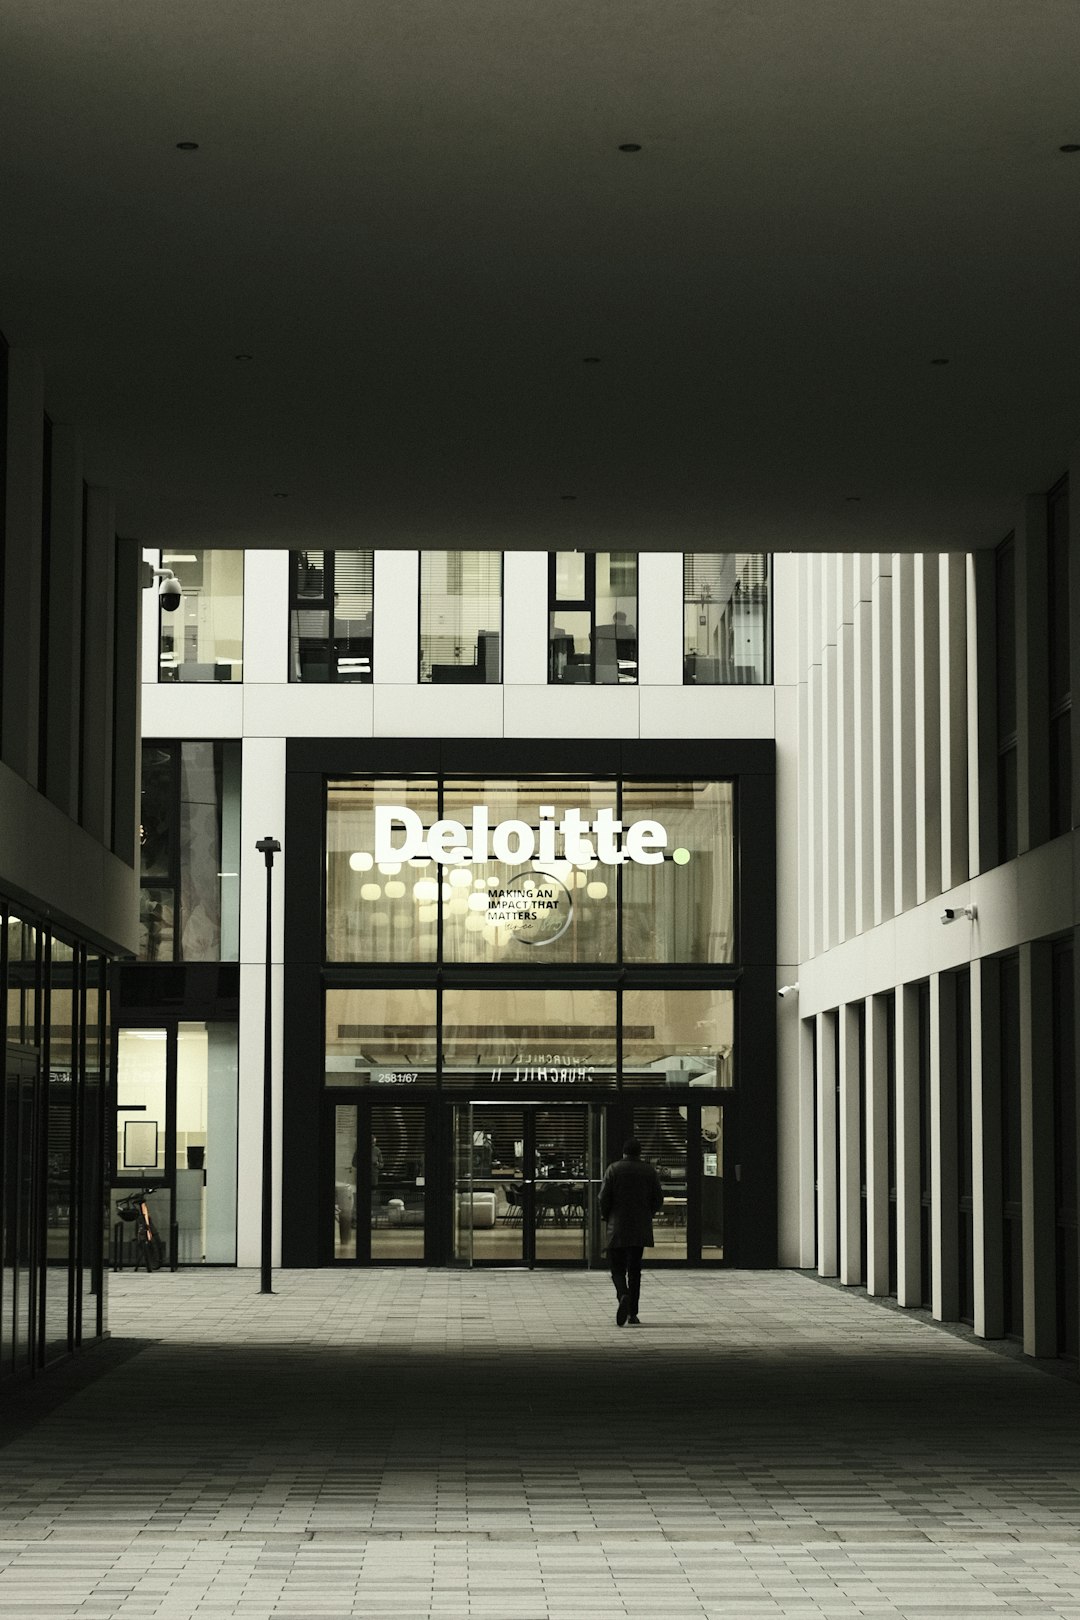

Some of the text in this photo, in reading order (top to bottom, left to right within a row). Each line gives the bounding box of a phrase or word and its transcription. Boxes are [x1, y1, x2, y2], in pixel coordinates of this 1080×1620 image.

[488, 889, 553, 898] MAKING AN
[488, 900, 559, 909] IMPACT THAT
[487, 912, 537, 920] MATTERS
[378, 1073, 418, 1083] 2581/67
